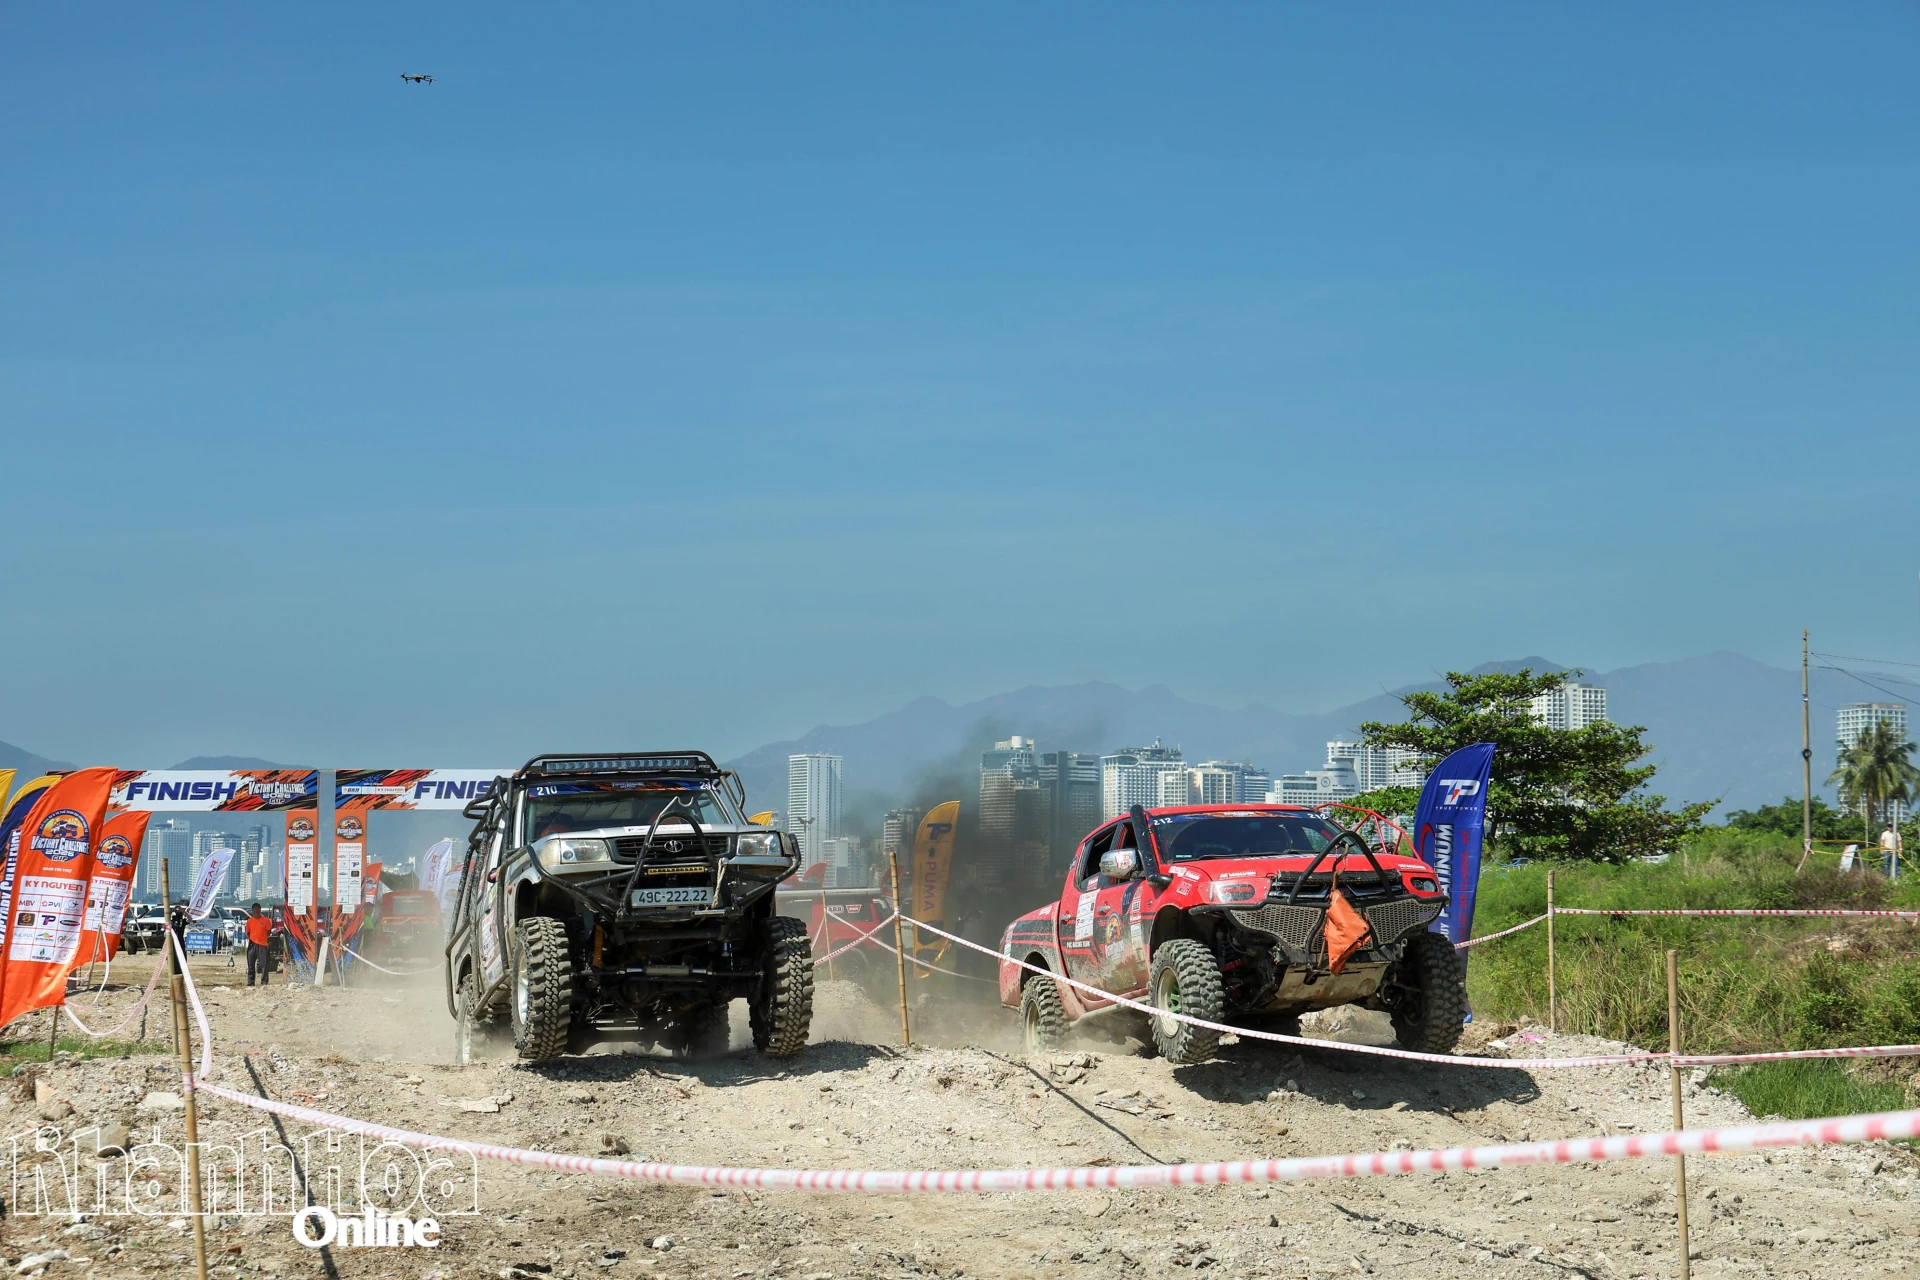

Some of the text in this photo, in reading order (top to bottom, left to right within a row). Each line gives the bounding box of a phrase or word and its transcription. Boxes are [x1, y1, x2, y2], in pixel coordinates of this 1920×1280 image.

[126, 781, 237, 801] FINISH
[414, 780, 498, 799] FINIS
[536, 785, 558, 797] 210
[1439, 779, 1480, 805] TP
[1153, 817, 1174, 826] 212
[926, 822, 953, 841] TP
[923, 861, 937, 912] PUMA
[19, 899, 36, 907] MBV
[638, 889, 708, 903] 49C-222.22
[41, 914, 57, 926] TP
